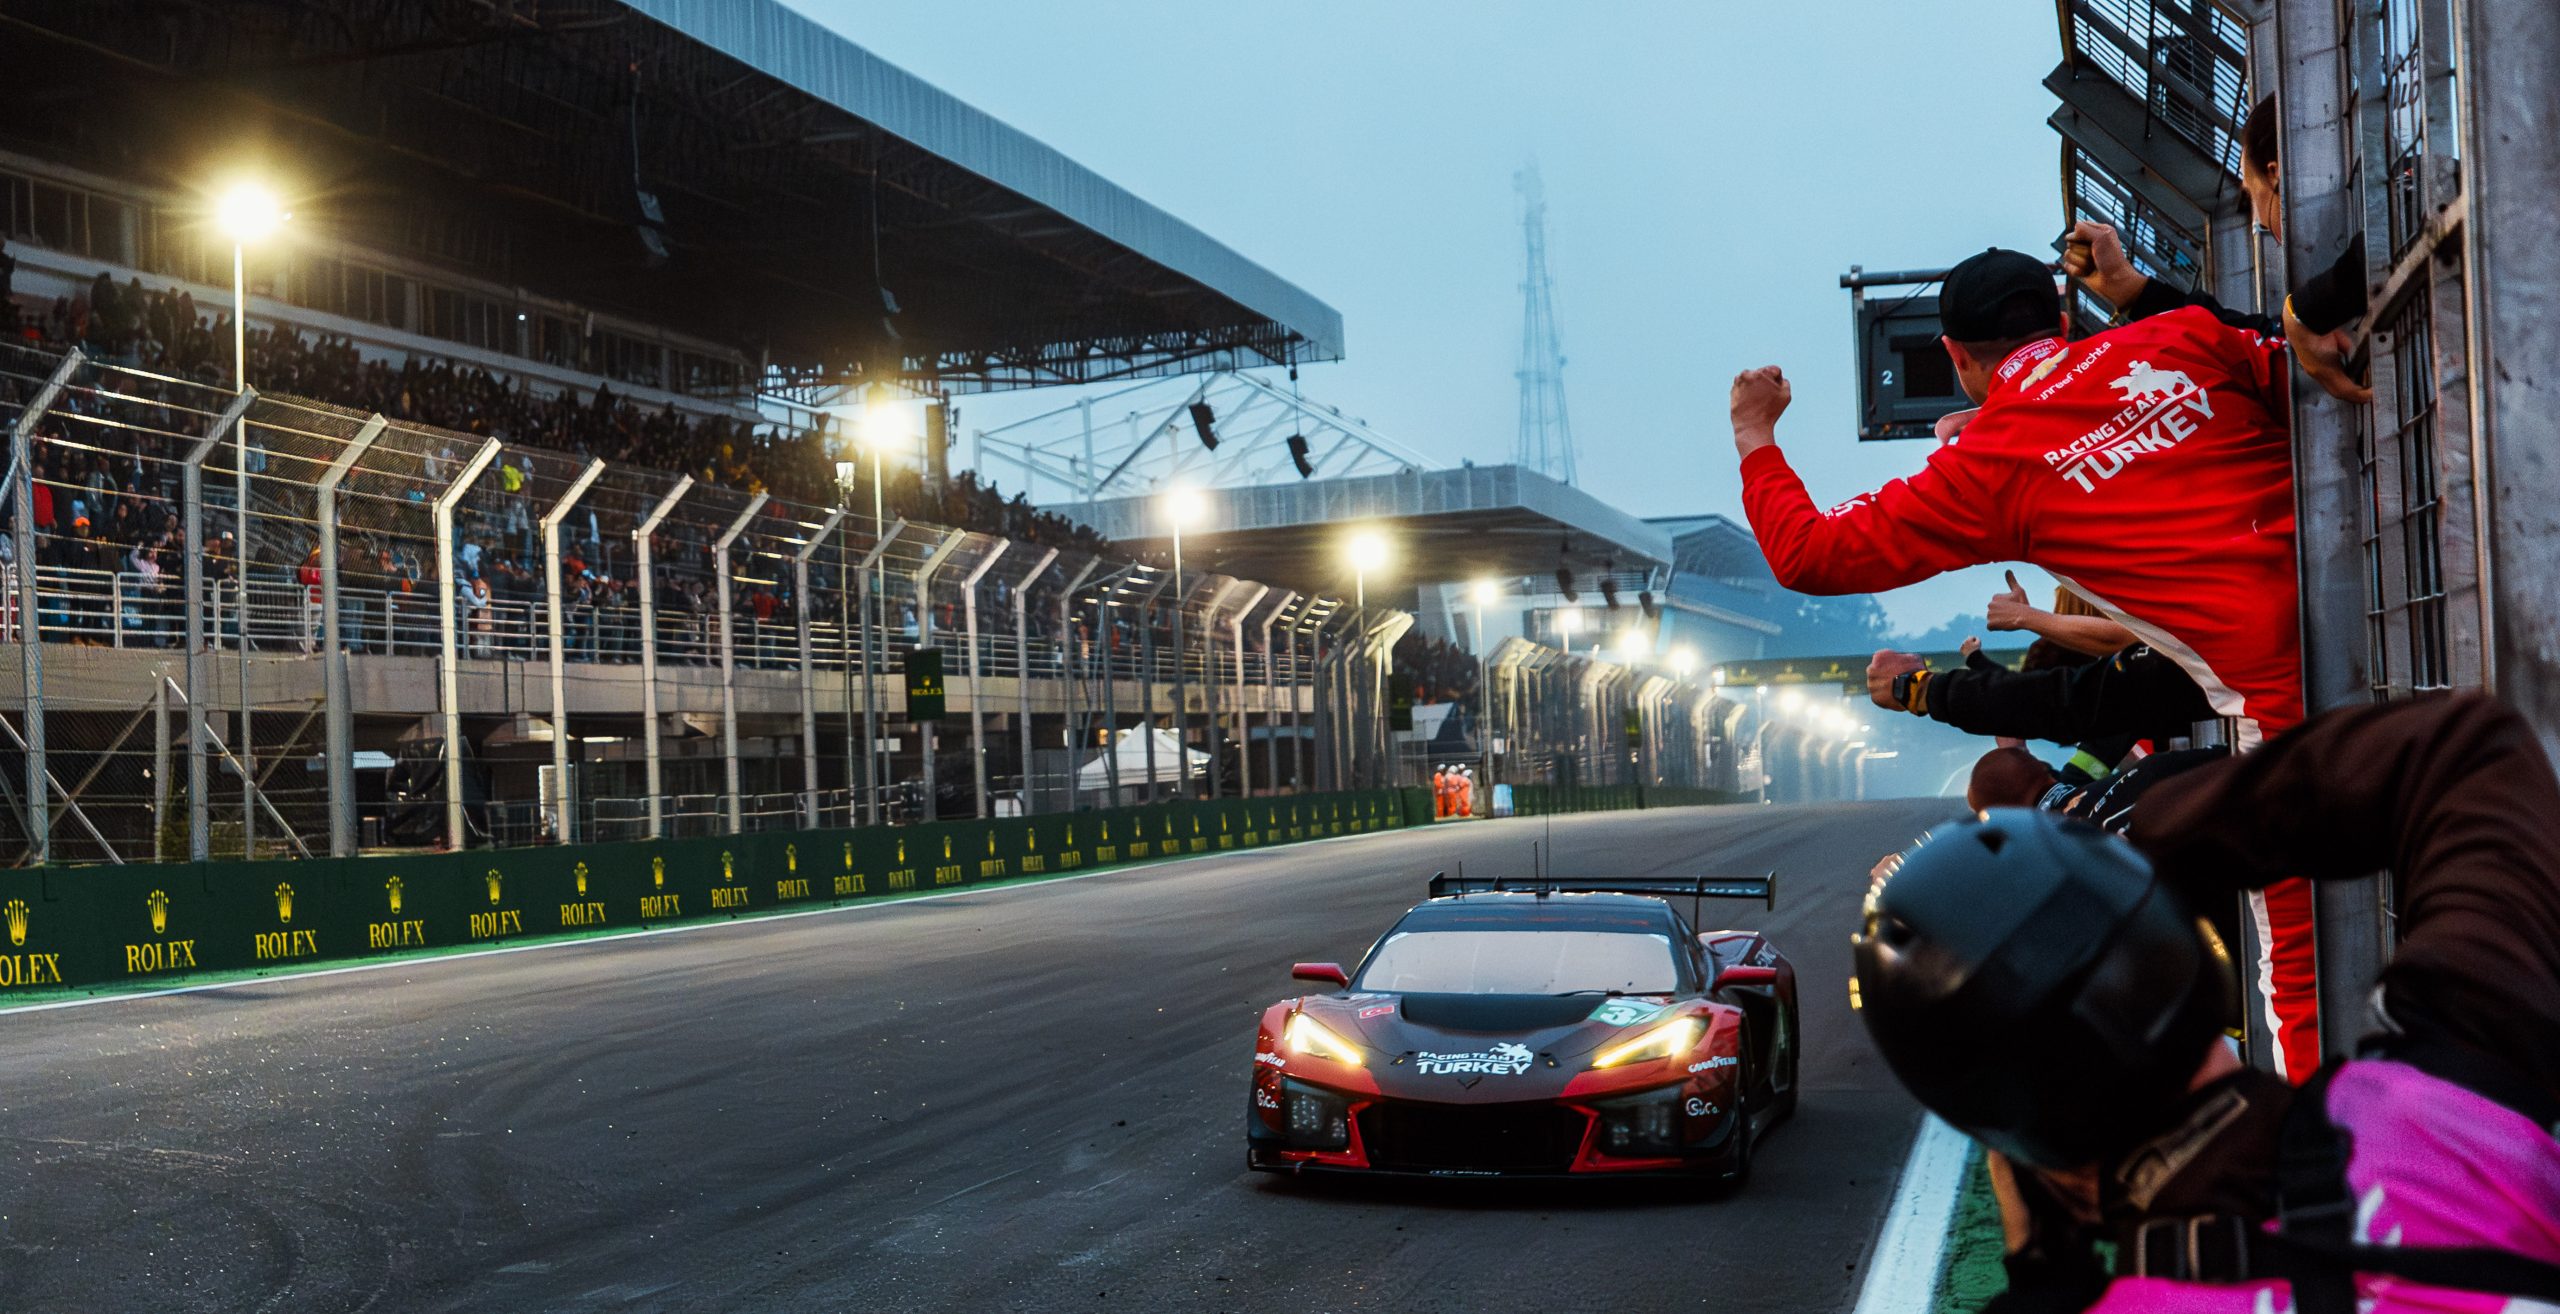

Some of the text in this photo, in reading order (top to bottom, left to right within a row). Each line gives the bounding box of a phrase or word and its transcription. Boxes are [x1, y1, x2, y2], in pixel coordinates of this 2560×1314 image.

[2072, 341, 2112, 374] Yachts
[1881, 369, 1893, 385] 2
[2043, 422, 2117, 466] RACING
[2062, 388, 2216, 494] TURKEY
[640, 894, 681, 919] ROLEX
[711, 886, 749, 908] ROLEX
[470, 909, 522, 938] ROLEX
[560, 902, 606, 926] ROLEX
[255, 929, 318, 960] ROLEX
[369, 920, 425, 948] ROLEX
[0, 953, 62, 987] OLEX
[125, 940, 196, 973] ROLEX
[1416, 1061, 1532, 1075] TURKEY
[1419, 1051, 1470, 1061] RACING
